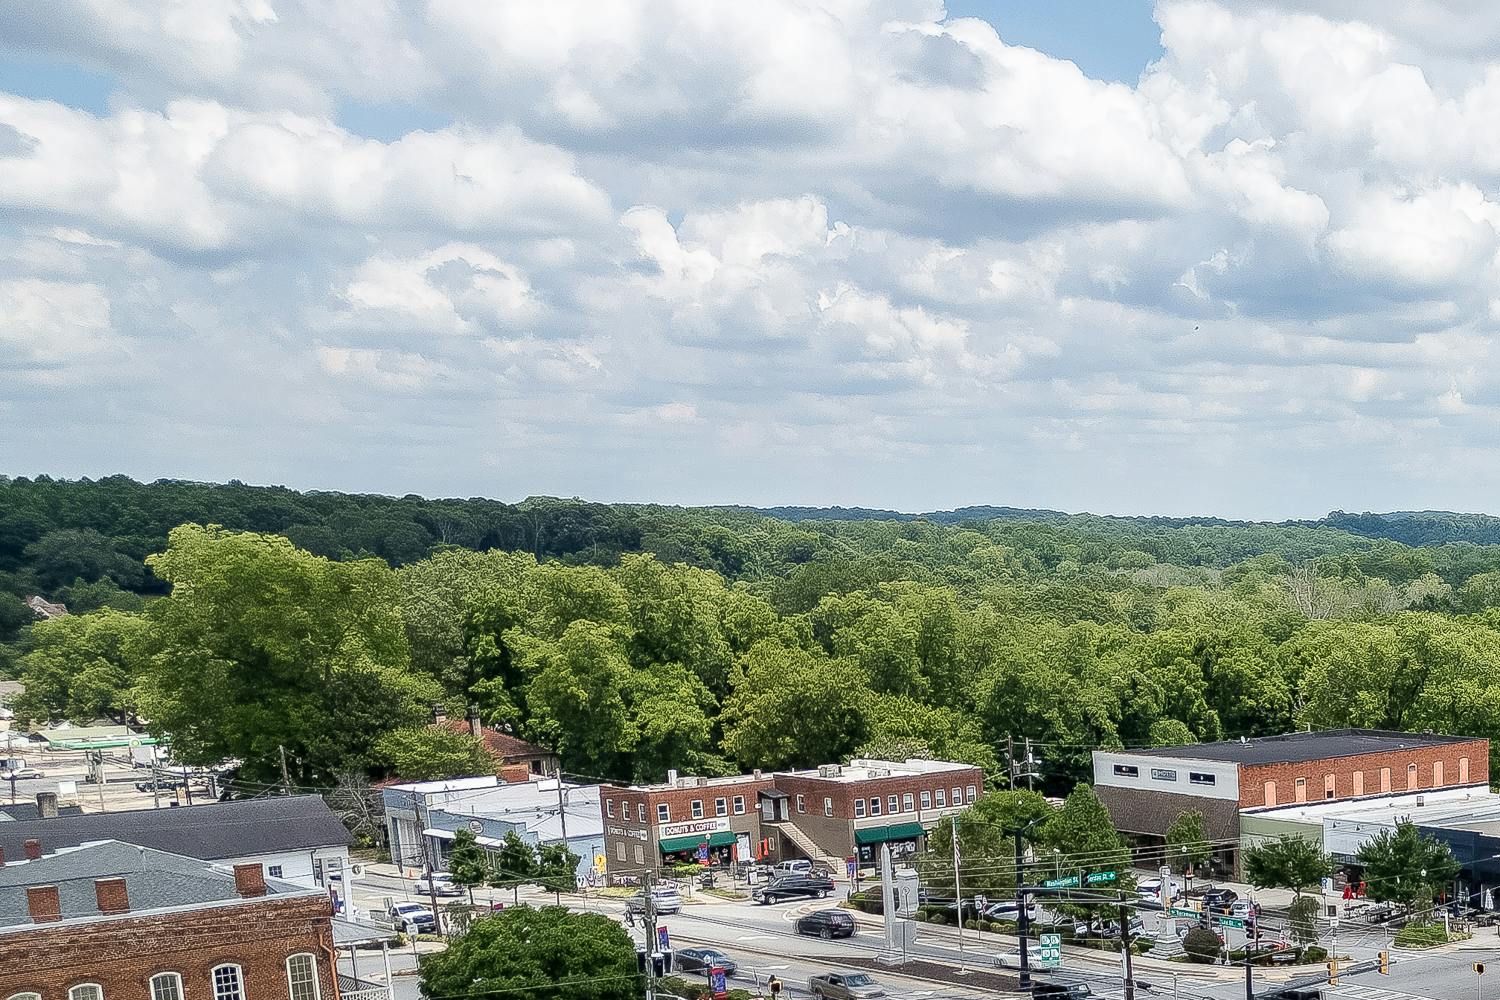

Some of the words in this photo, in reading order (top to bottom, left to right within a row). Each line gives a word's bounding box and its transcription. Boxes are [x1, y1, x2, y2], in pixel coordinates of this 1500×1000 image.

[665, 825, 689, 835] DONUTS
[689, 824, 695, 832] &
[695, 821, 717, 832] COFFEE
